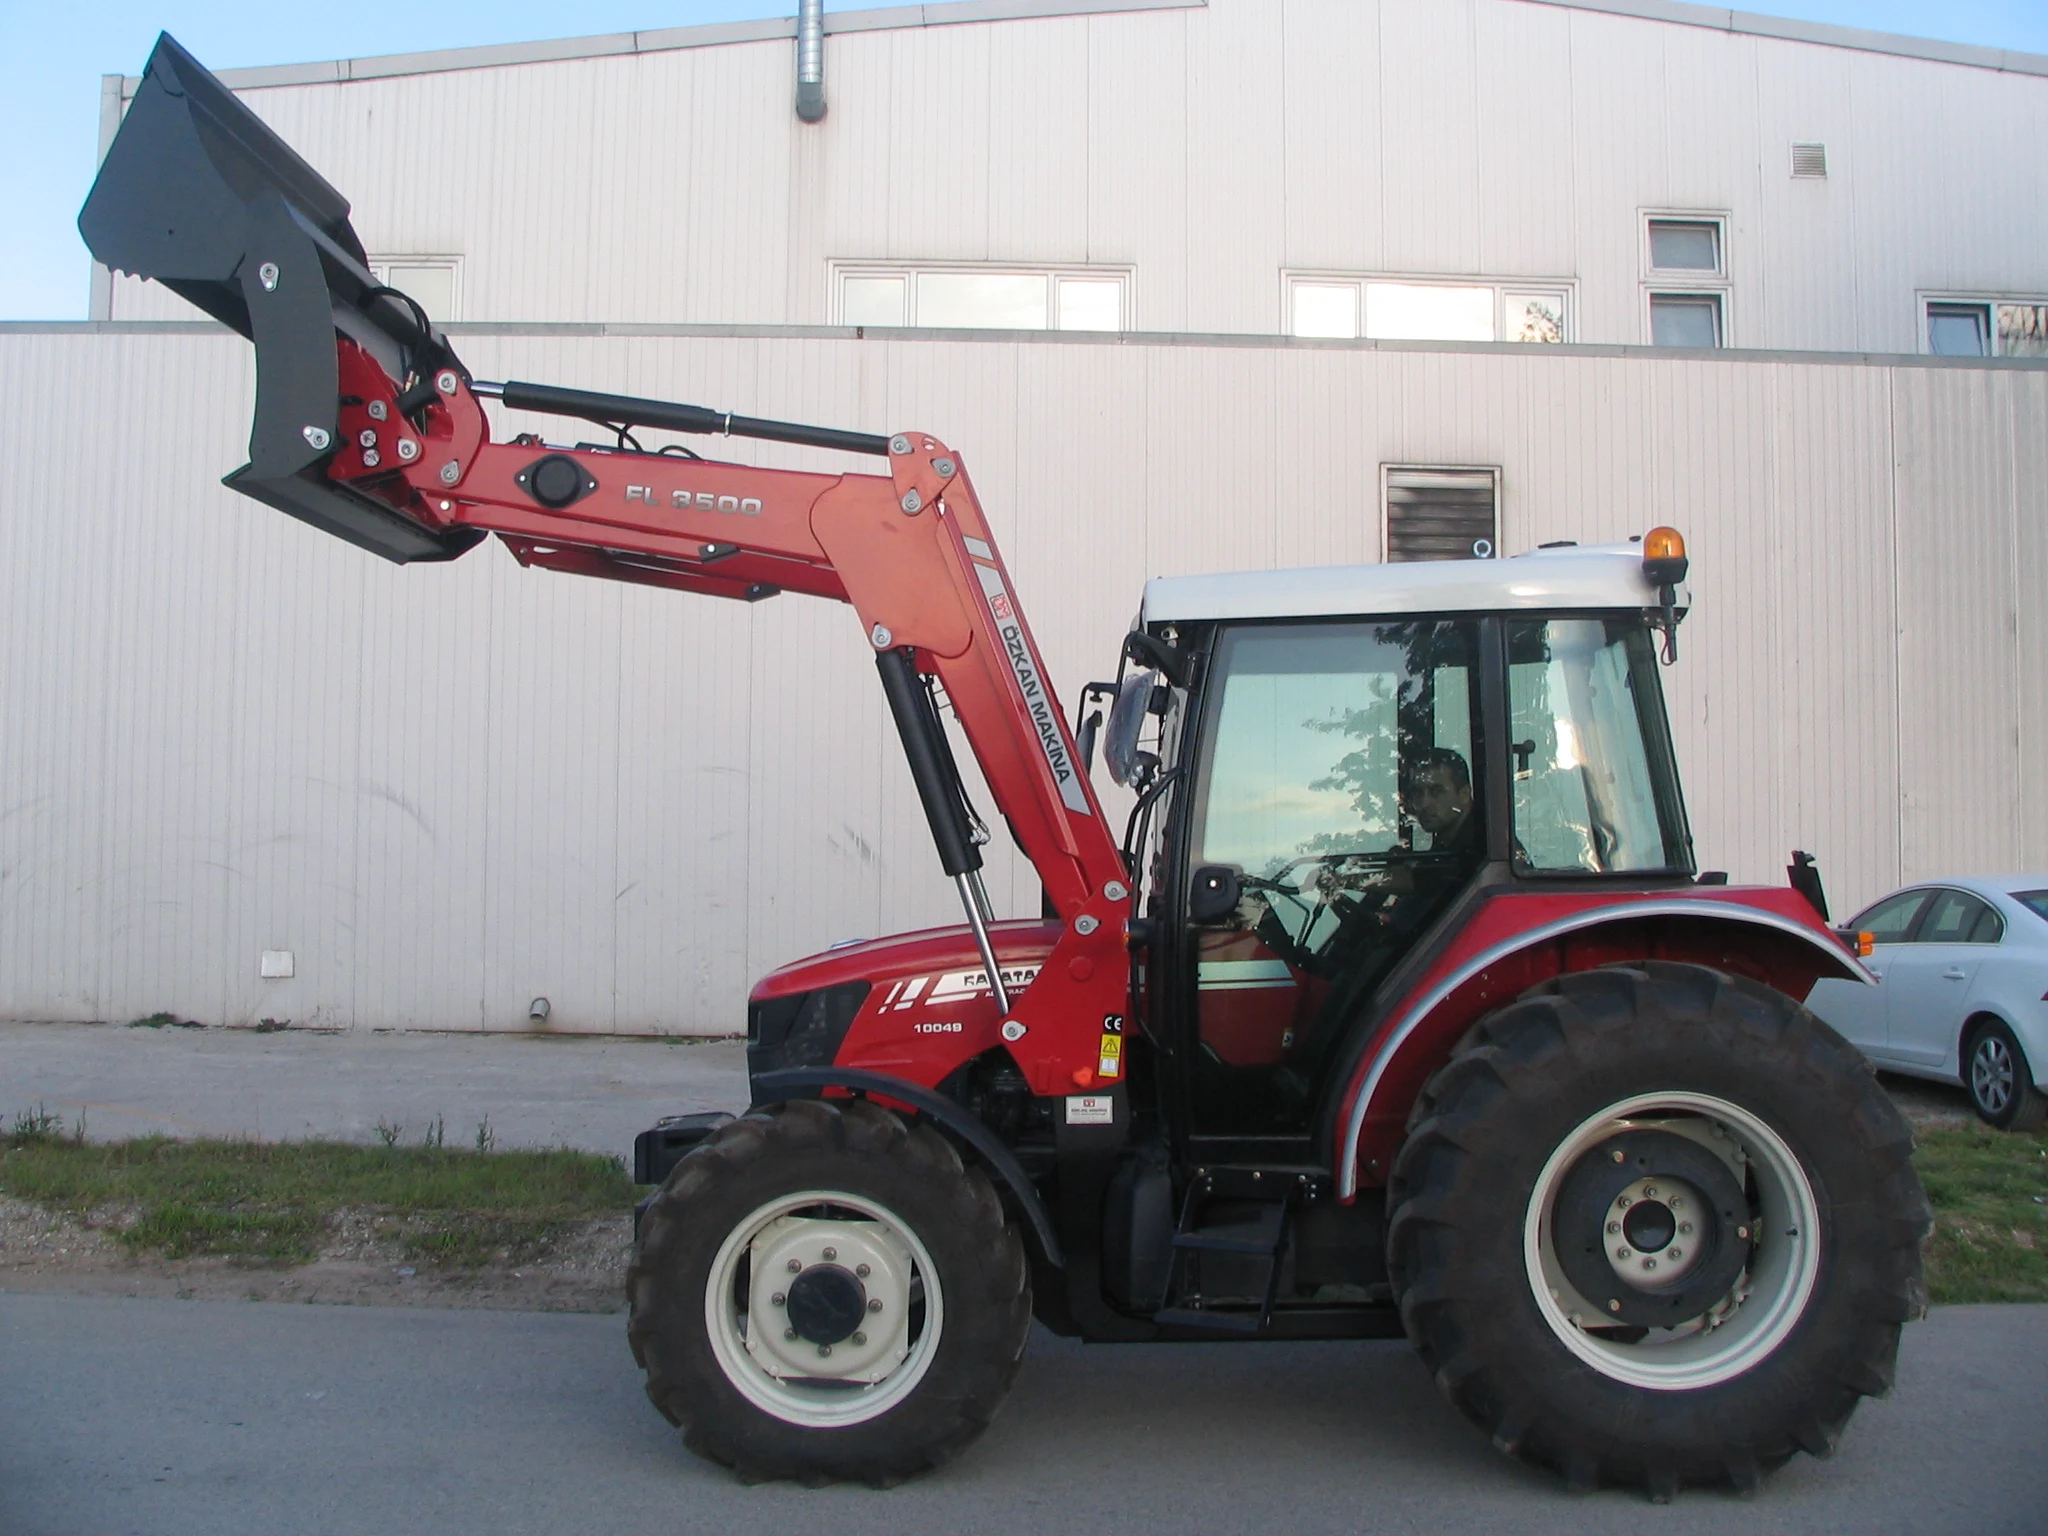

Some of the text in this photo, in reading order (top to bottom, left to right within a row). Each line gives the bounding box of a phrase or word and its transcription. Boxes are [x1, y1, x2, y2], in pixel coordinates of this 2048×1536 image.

[625, 485, 762, 516] FL 3500
[1002, 625, 1071, 784] ÖZKAN MAKİNA
[913, 1022, 962, 1033] 10049
[1104, 1016, 1122, 1031] CE
